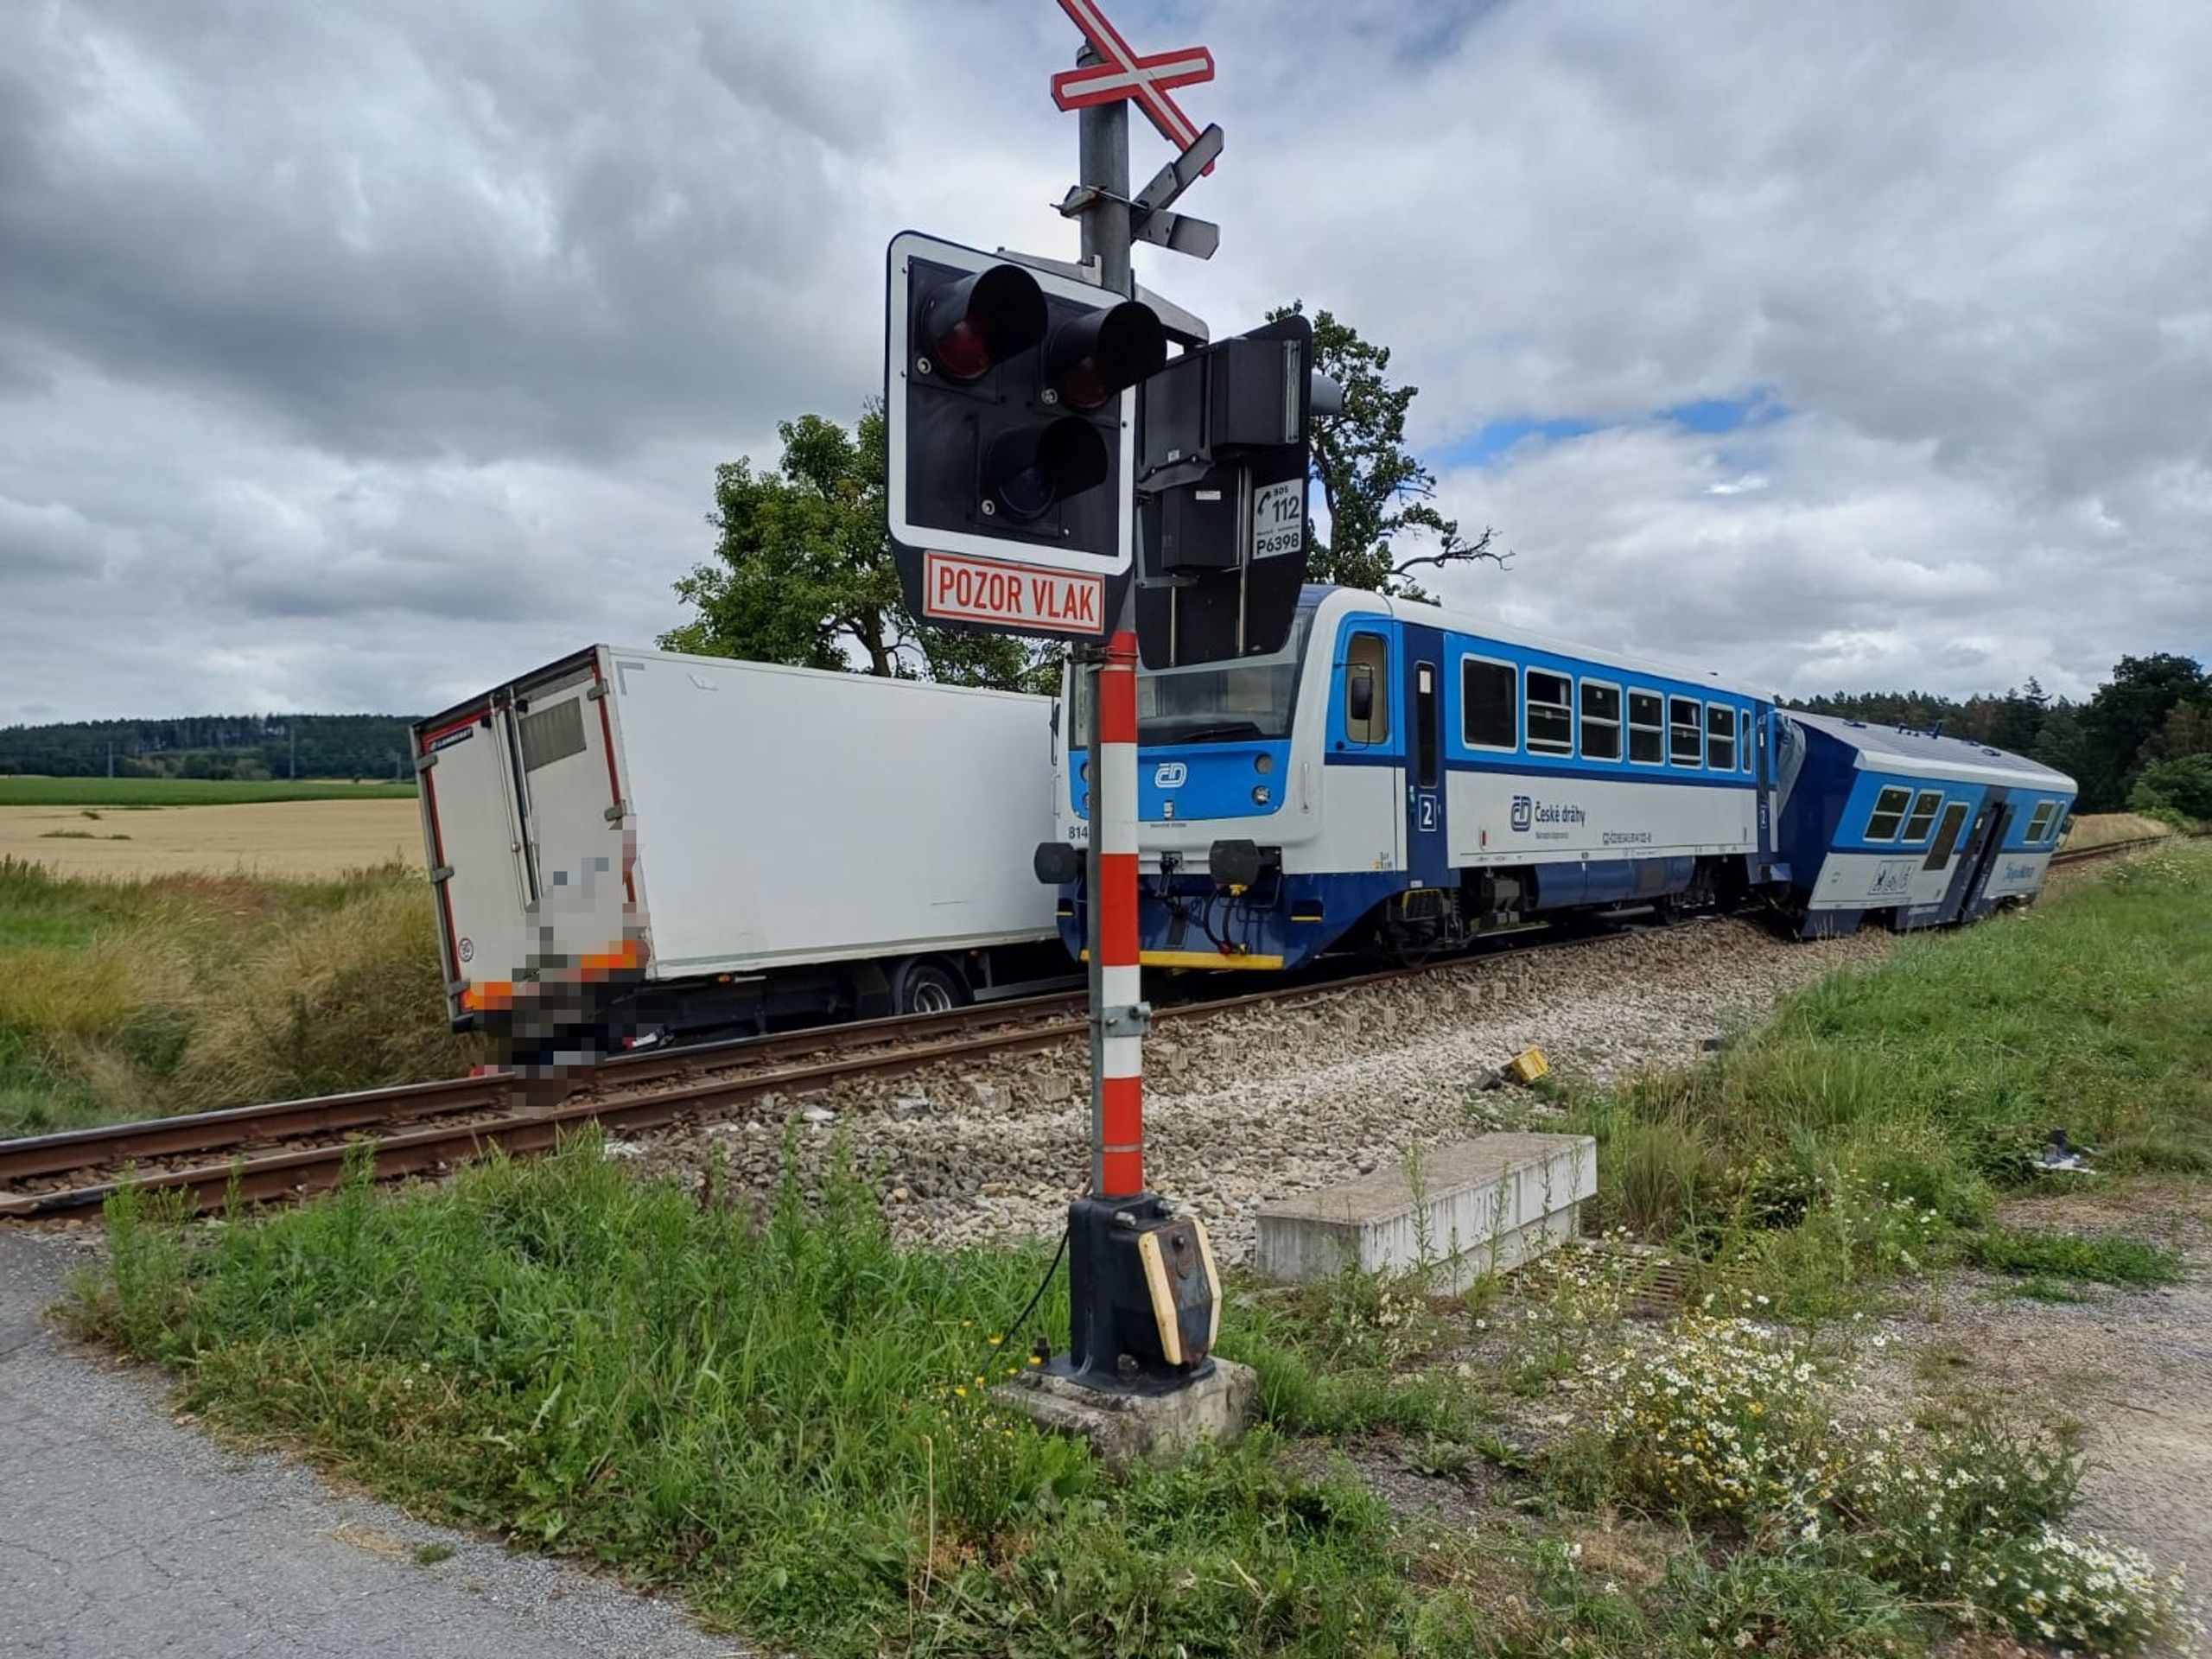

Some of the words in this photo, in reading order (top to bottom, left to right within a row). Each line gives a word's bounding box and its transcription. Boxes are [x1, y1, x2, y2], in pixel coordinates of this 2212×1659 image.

[1273, 486, 1289, 497] SOS
[1272, 495, 1300, 524] 112
[1256, 532, 1300, 555] P6398
[938, 566, 1023, 613] POZOR
[1032, 578, 1095, 622] VLAK
[1422, 801, 1433, 825] 2
[1535, 800, 1560, 823] České
[1561, 804, 1586, 827] dráhy
[1068, 825, 1089, 840] 814
